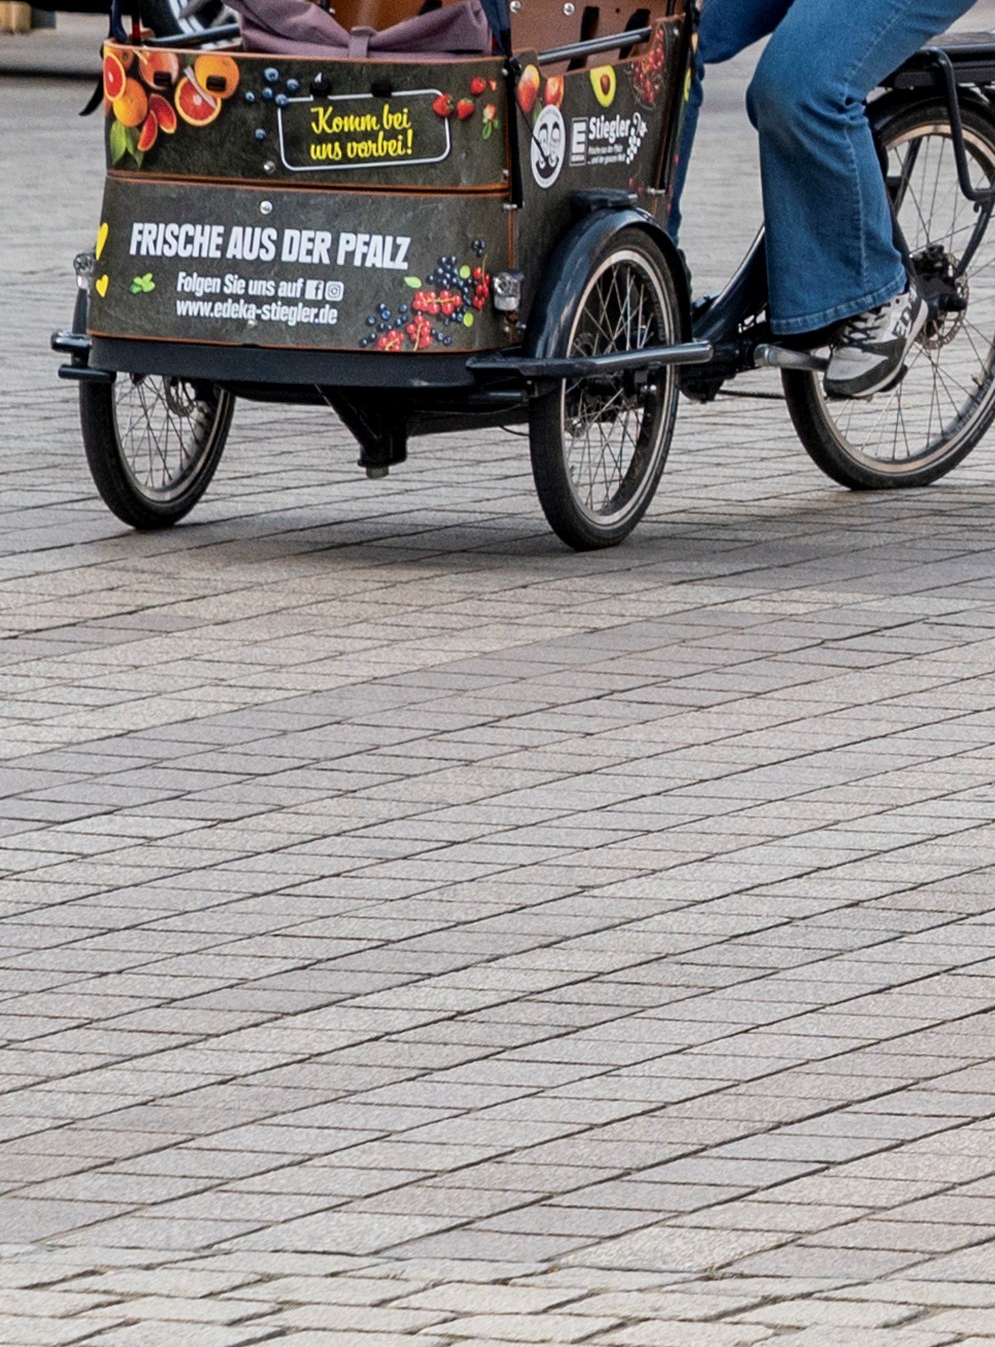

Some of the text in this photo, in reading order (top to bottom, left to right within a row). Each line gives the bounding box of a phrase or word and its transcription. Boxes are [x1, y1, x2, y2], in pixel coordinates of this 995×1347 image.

[310, 104, 411, 134] Komm bei
[589, 114, 630, 143] Stiegler
[310, 132, 413, 161] uns vorbei!
[129, 222, 411, 270] FRISCHE AUS DER PFALZ
[177, 271, 221, 297] Folgen
[223, 274, 247, 295] Sie
[250, 279, 274, 297] uns
[276, 278, 304, 299] auf
[176, 298, 338, 326] www.edeka-stiegler.de
